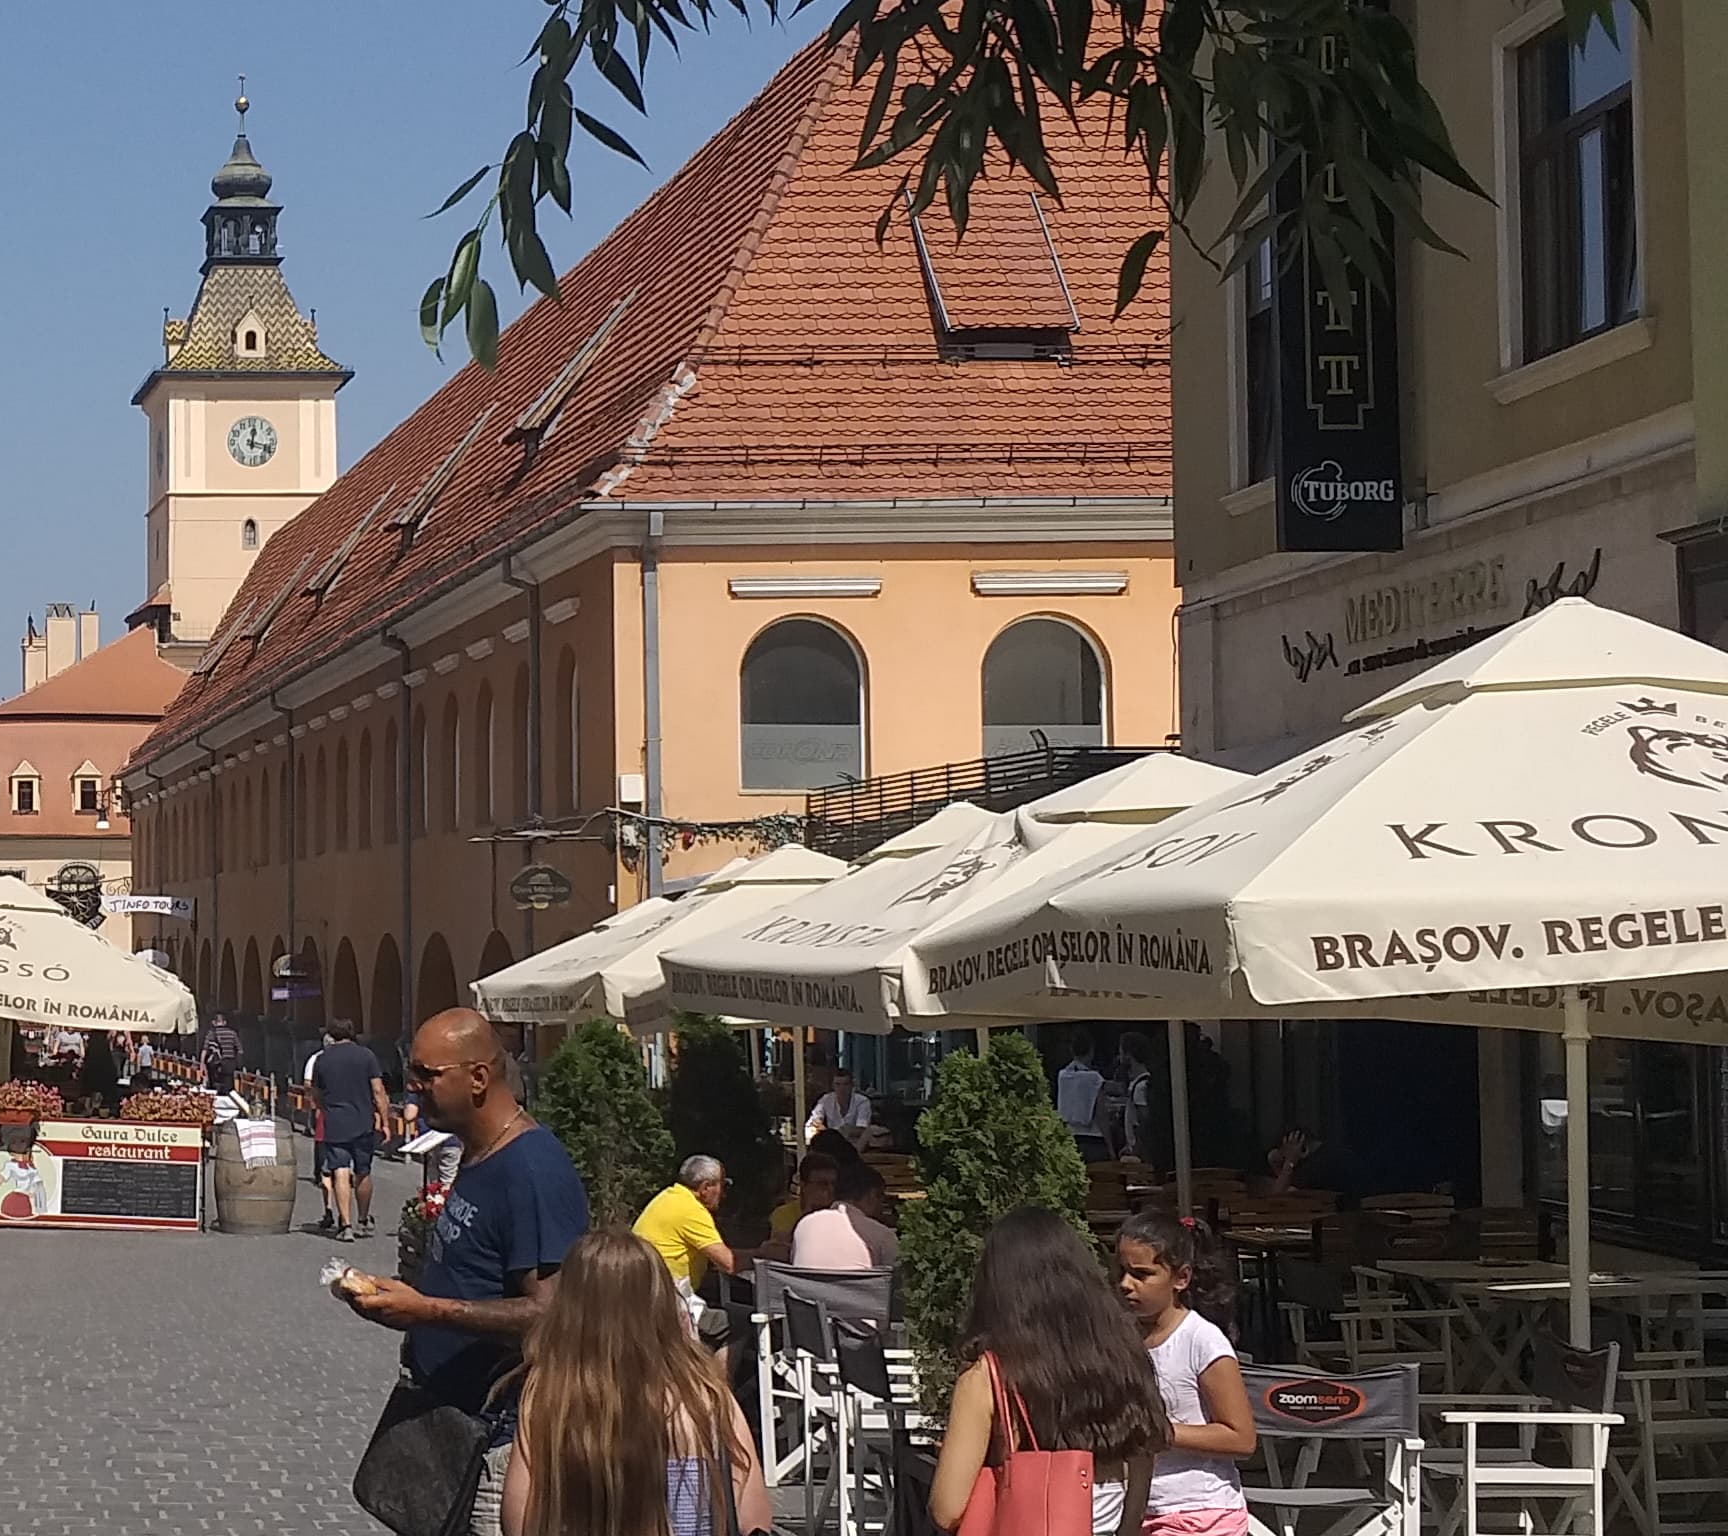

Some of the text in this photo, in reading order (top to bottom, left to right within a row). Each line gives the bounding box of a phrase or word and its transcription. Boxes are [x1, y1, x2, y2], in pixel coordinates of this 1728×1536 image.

[1304, 478, 1394, 503] TUBORG
[1309, 905, 1727, 973] BRAȘOV. REGELE
[43, 998, 61, 1015] ÎN
[67, 1004, 156, 1023] ROMÂNIA.
[81, 1126, 178, 1143] Gaura Dulce
[88, 1143, 171, 1159] restaurant
